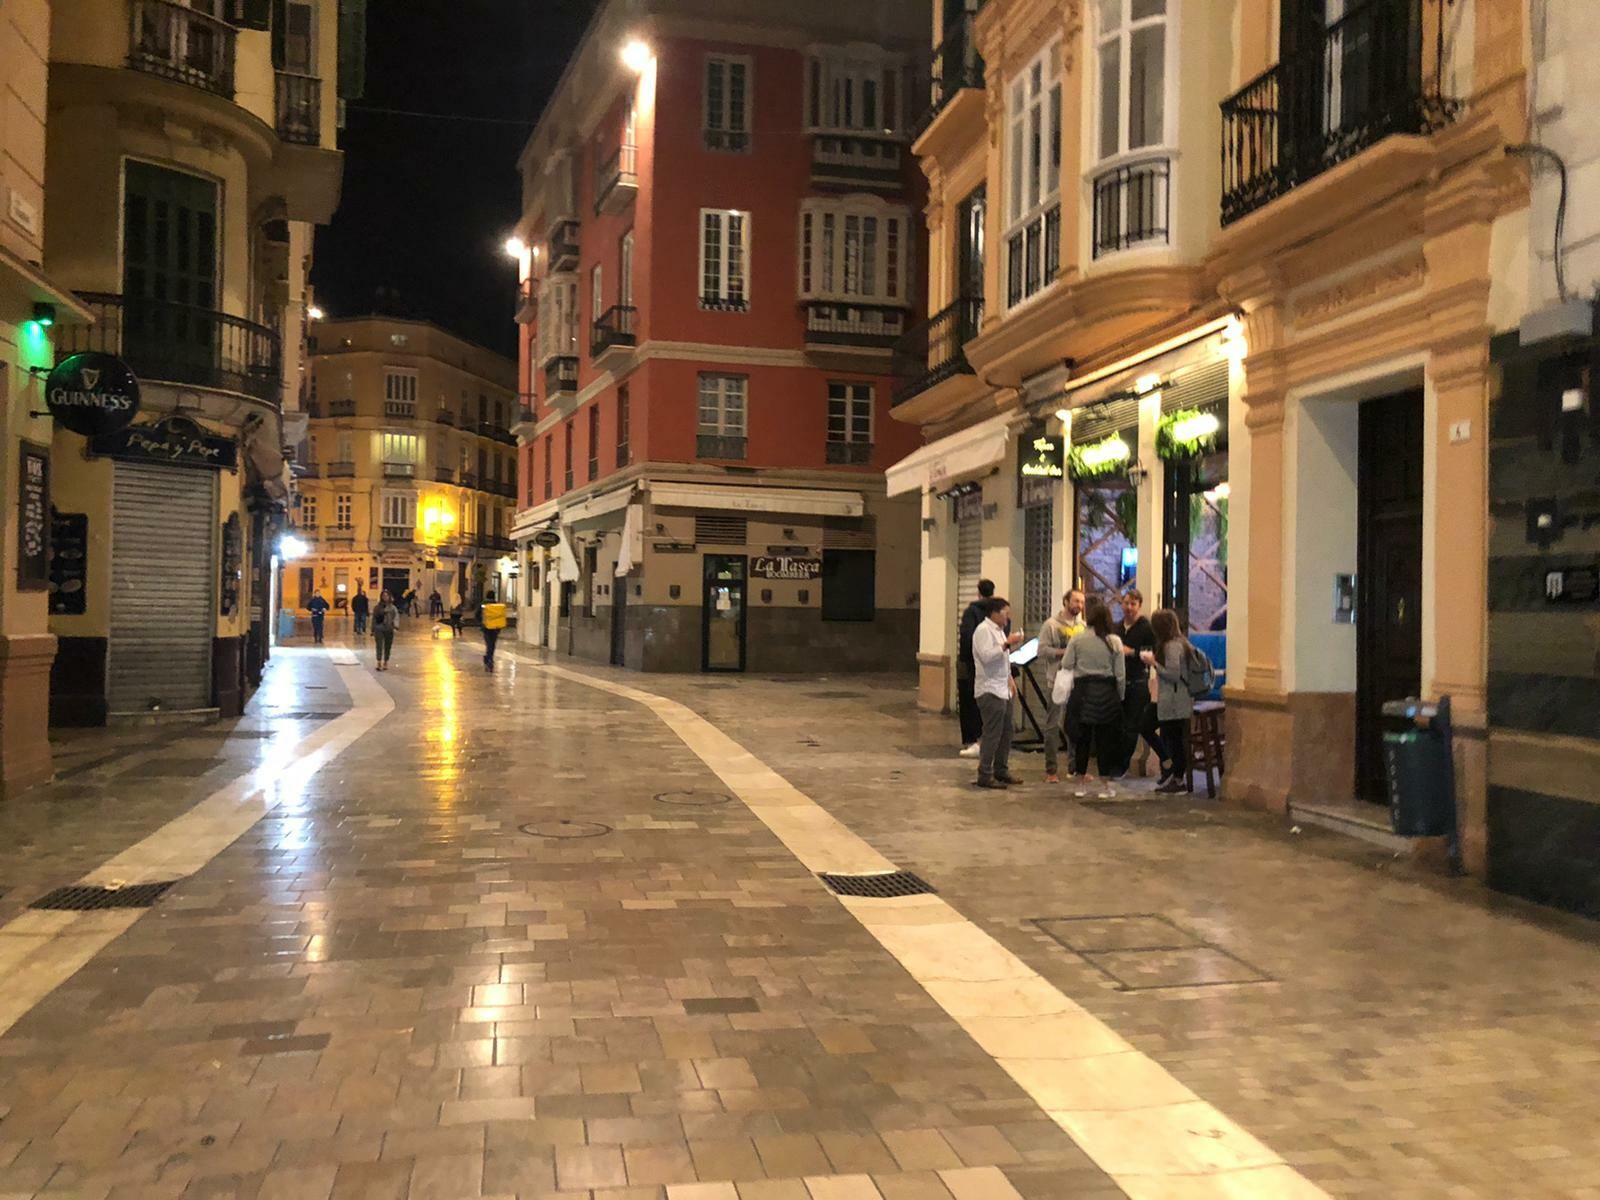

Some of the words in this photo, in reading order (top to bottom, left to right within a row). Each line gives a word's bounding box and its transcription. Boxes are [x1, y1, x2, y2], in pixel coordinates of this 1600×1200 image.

[51, 388, 131, 410] GUINNESS
[127, 433, 171, 452] Pepa
[171, 446, 184, 459] y
[187, 440, 219, 457] Pepe
[754, 557, 774, 572] La
[776, 556, 820, 573] Tasca
